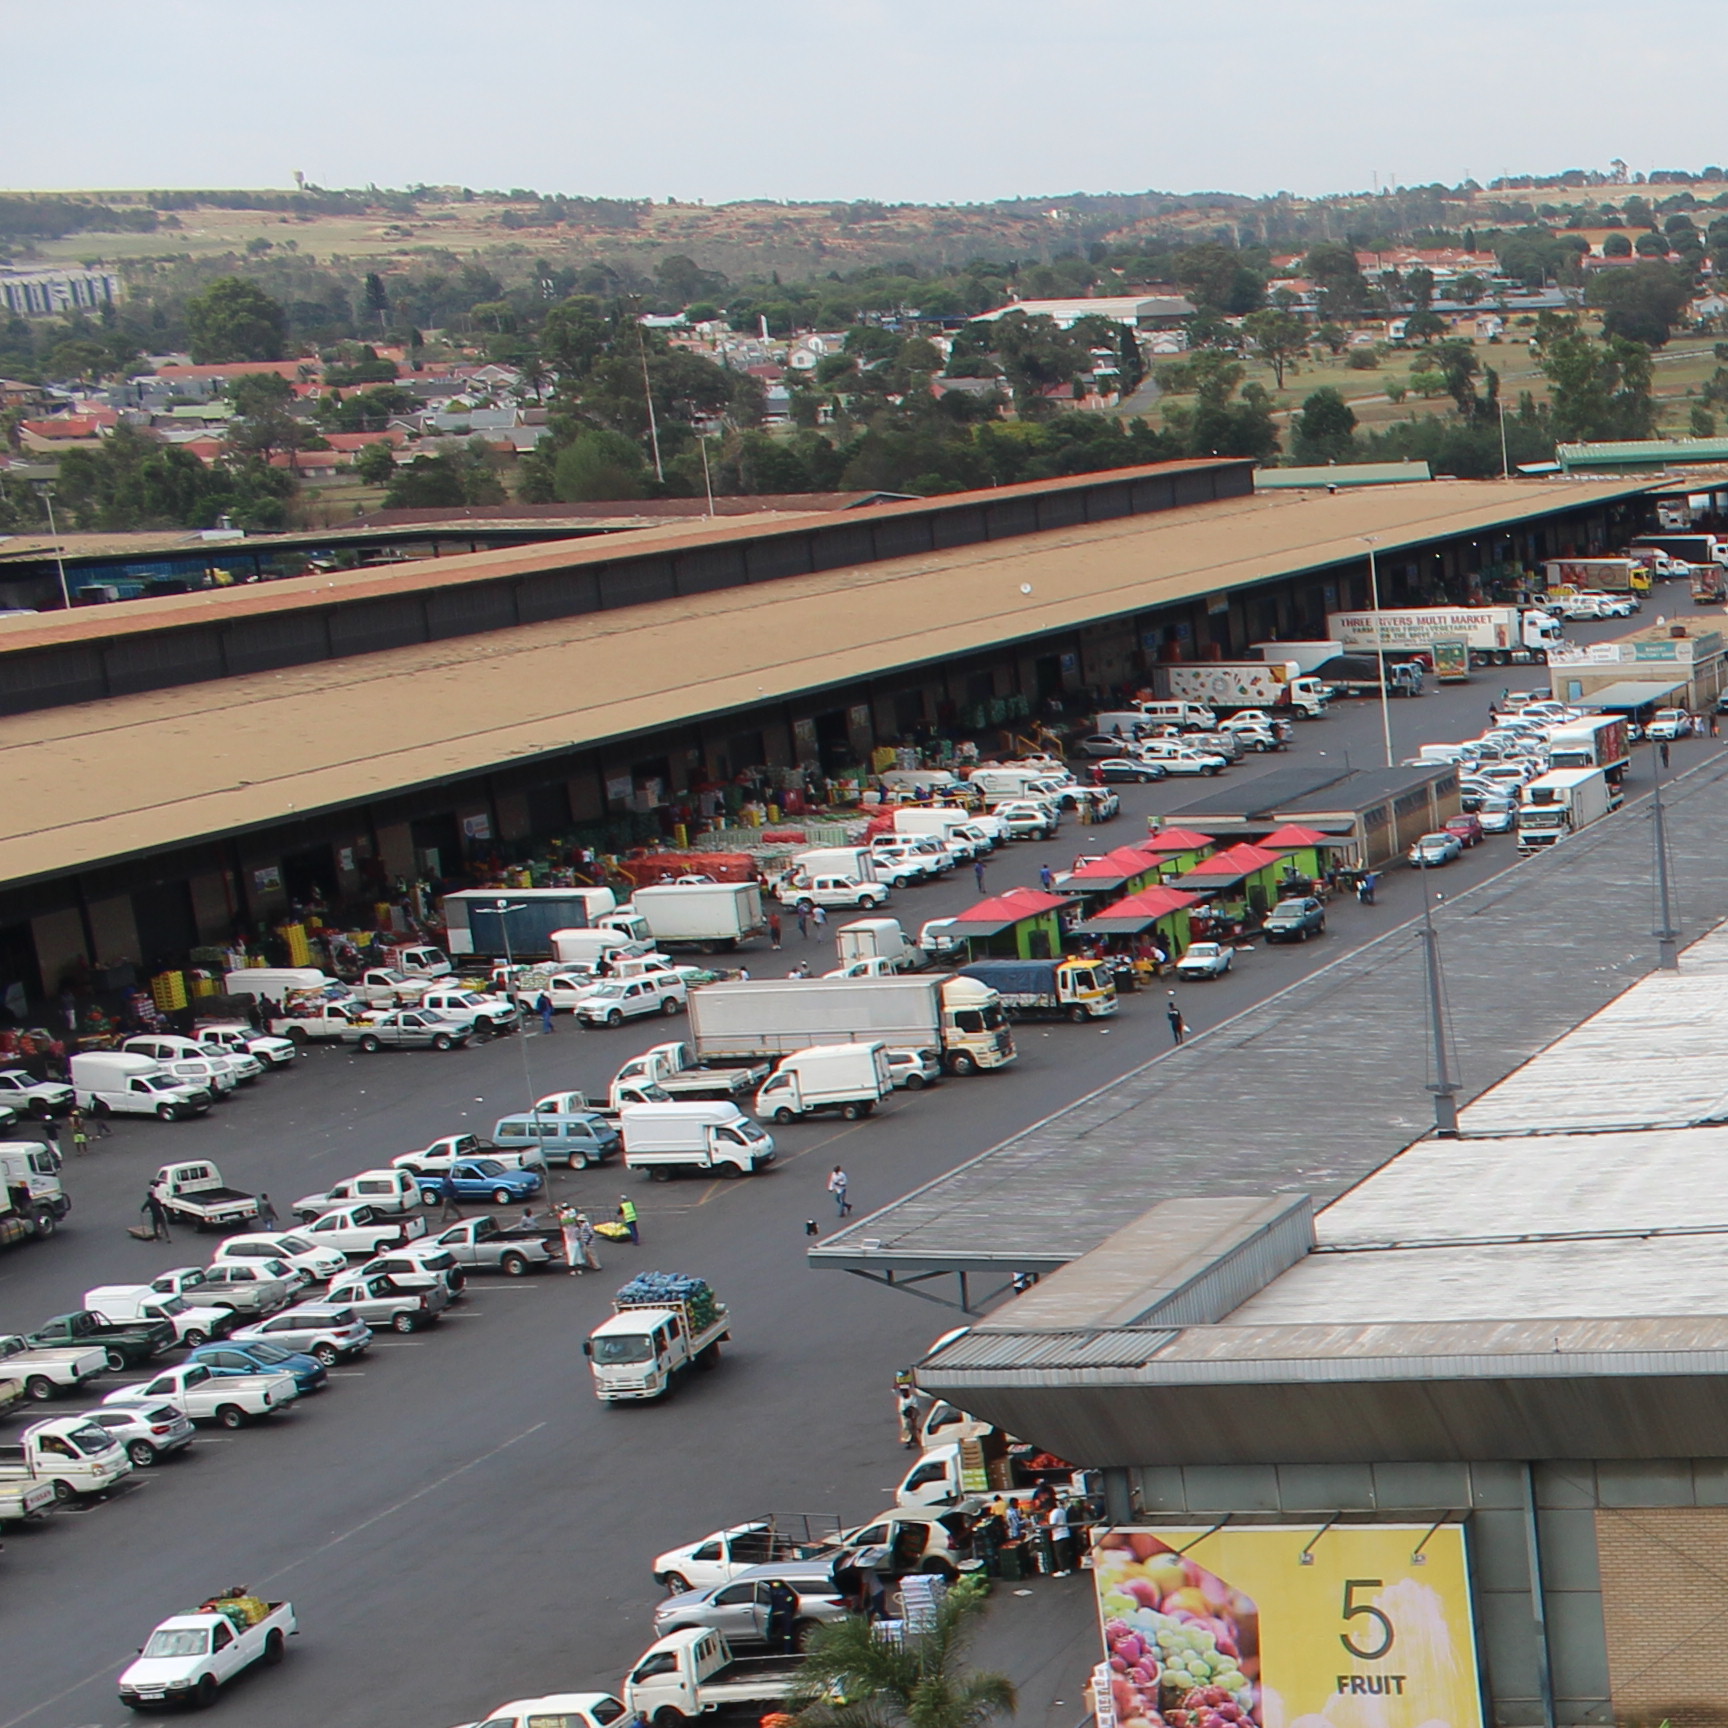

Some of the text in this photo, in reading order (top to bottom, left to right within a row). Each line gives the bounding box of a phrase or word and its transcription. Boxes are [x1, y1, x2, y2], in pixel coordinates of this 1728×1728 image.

[1341, 615, 1493, 627] THREE RIVERS MULTI MARKET
[1339, 1578, 1395, 1660] 5
[1336, 1673, 1406, 1695] FRUIT
